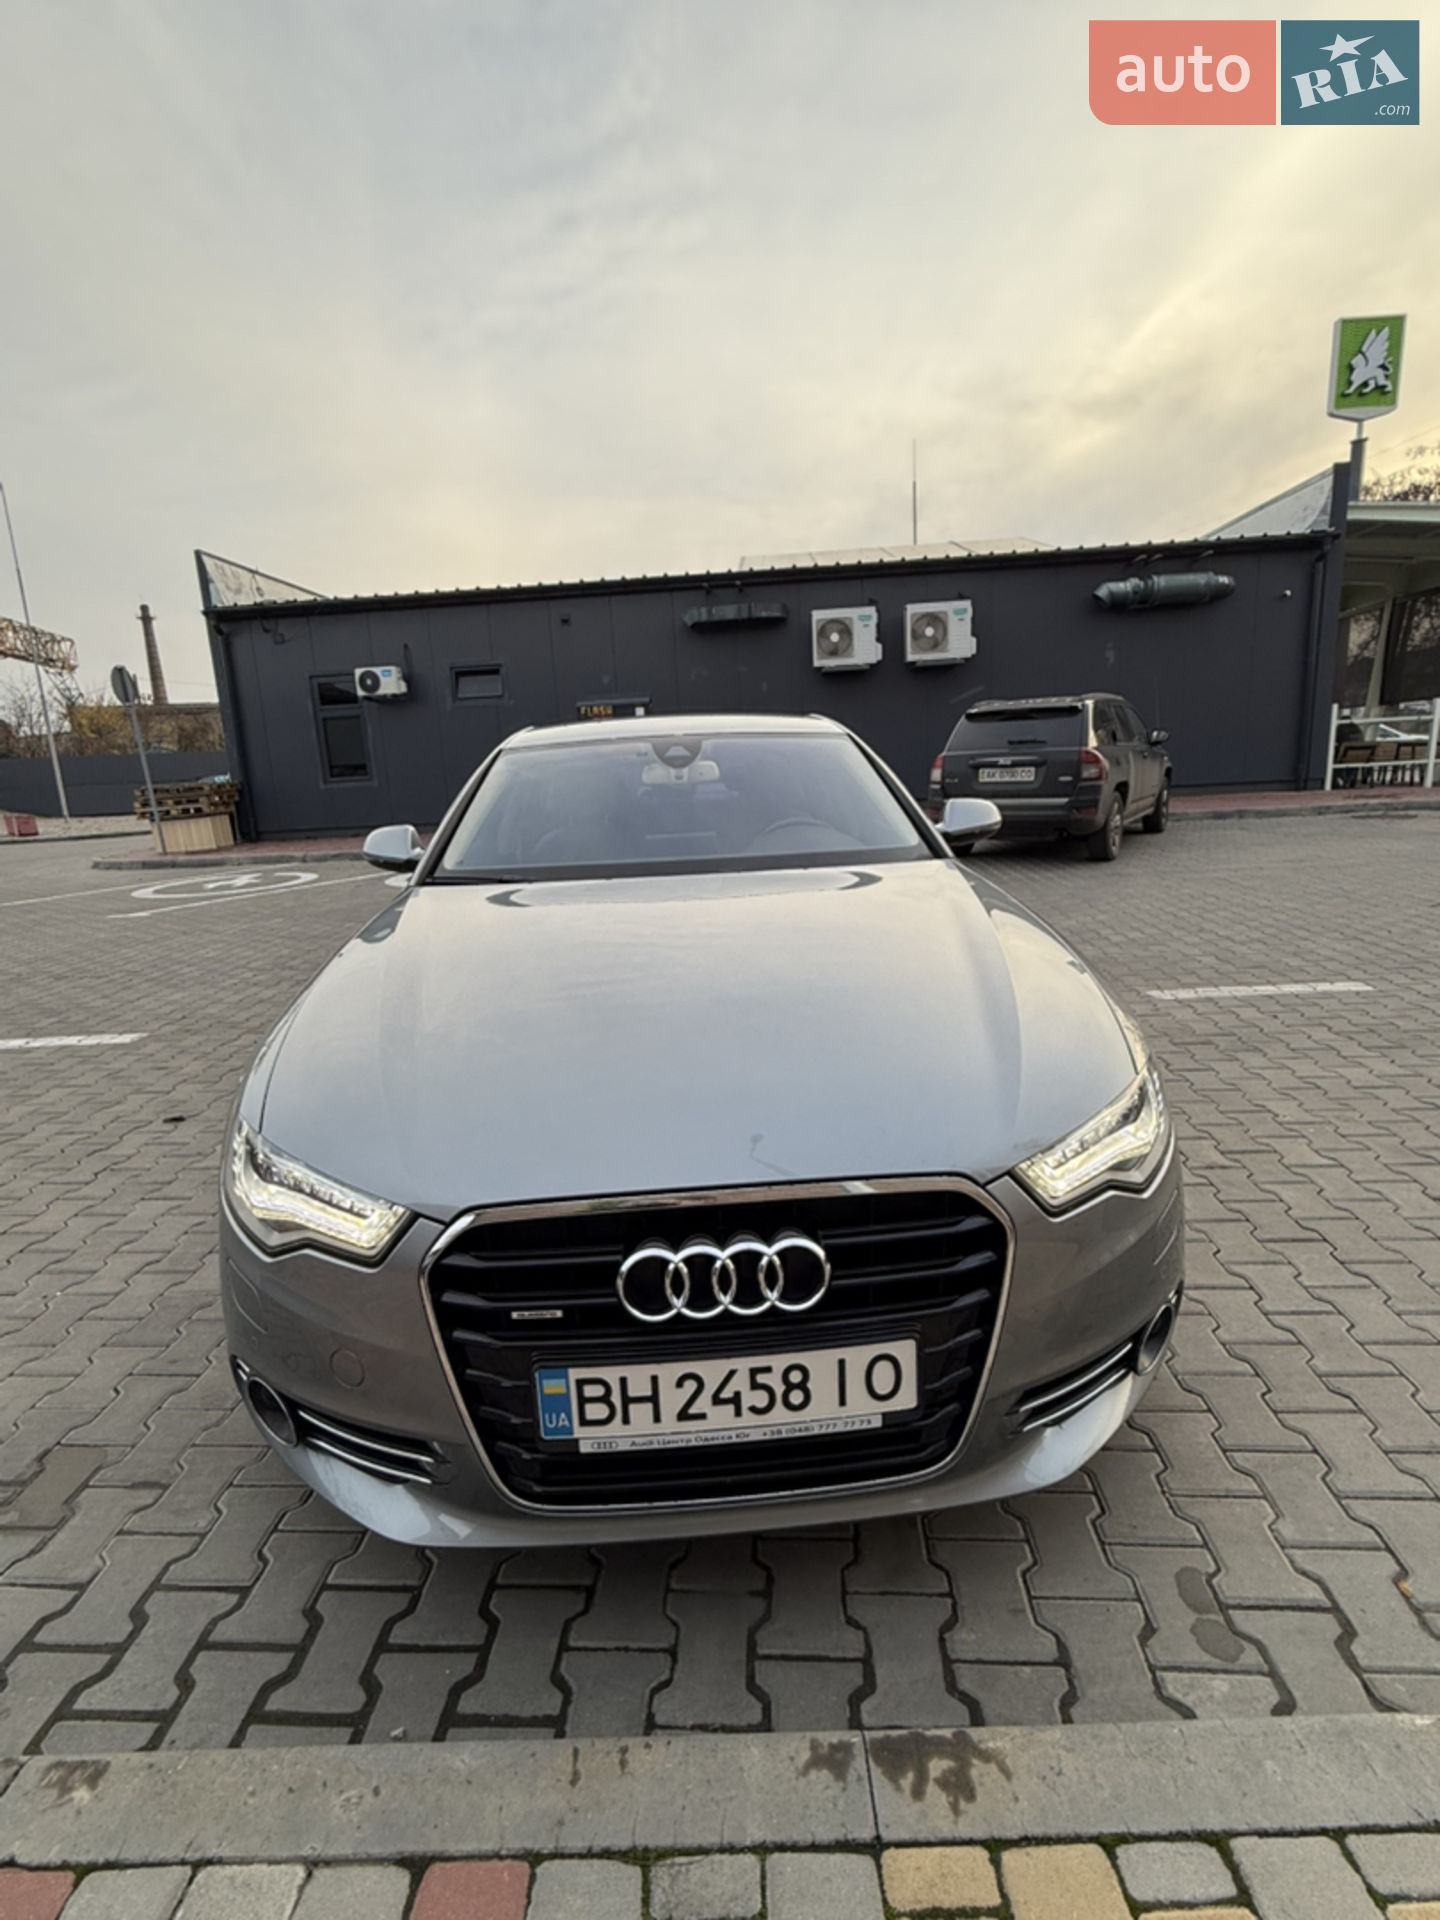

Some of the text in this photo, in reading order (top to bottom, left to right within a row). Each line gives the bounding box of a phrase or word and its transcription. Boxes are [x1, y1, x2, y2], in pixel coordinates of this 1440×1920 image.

[575, 1374, 662, 1428] BH
[675, 1363, 812, 1423] 2458
[545, 1411, 571, 1429] UA
[629, 1439, 655, 1448] Audi
[657, 1437, 692, 1448] Центр
[735, 1432, 751, 1441] Юг
